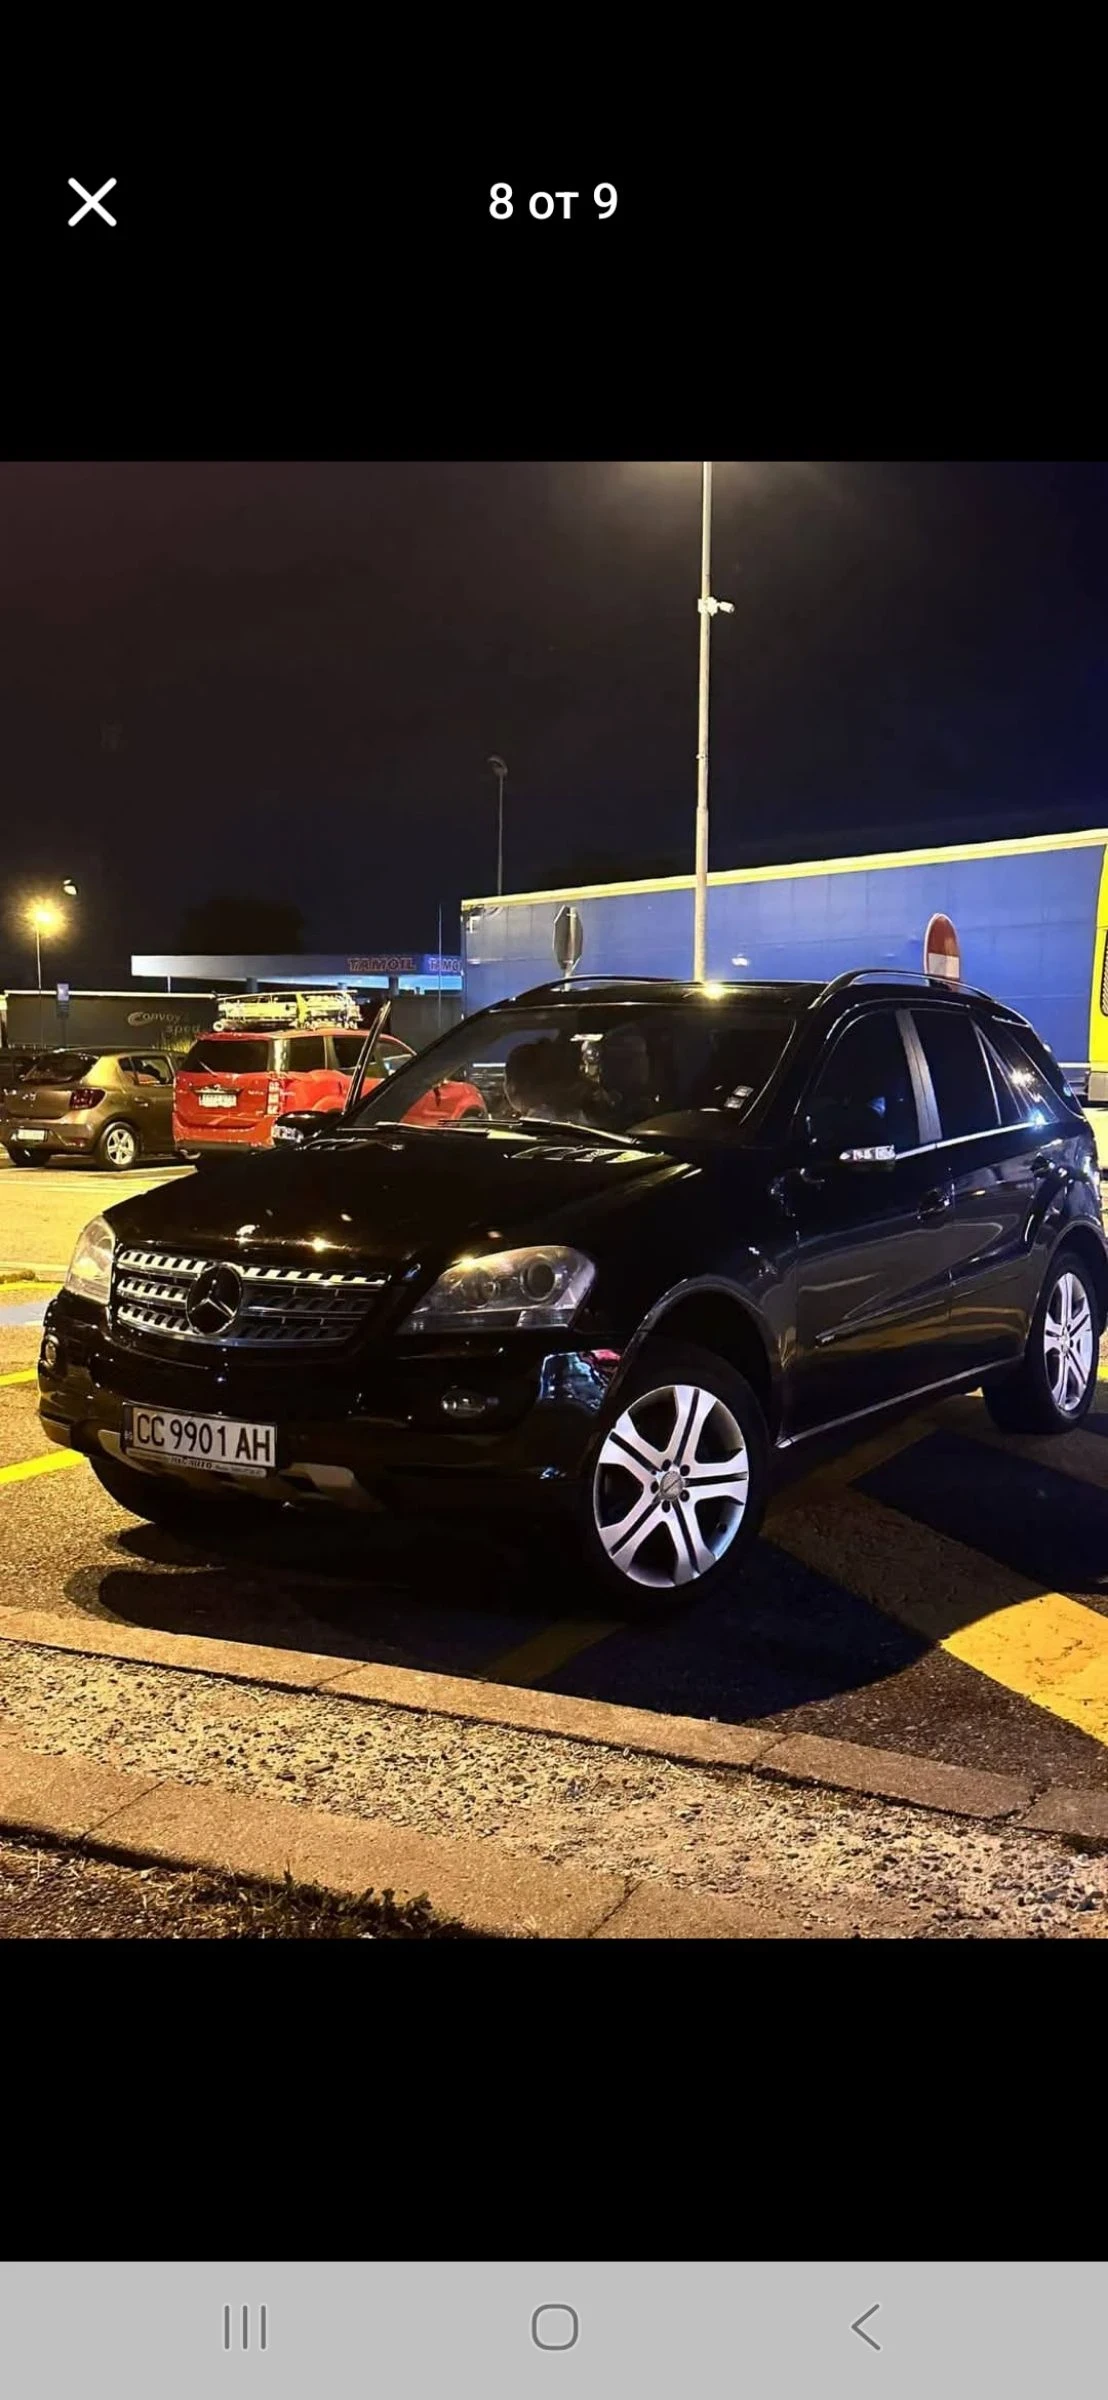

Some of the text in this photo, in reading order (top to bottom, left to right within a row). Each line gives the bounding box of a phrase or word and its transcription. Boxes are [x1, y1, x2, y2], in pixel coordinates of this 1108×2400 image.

[347, 957, 417, 972] TAMOIL
[136, 1413, 271, 1462] CC 9901 AH
